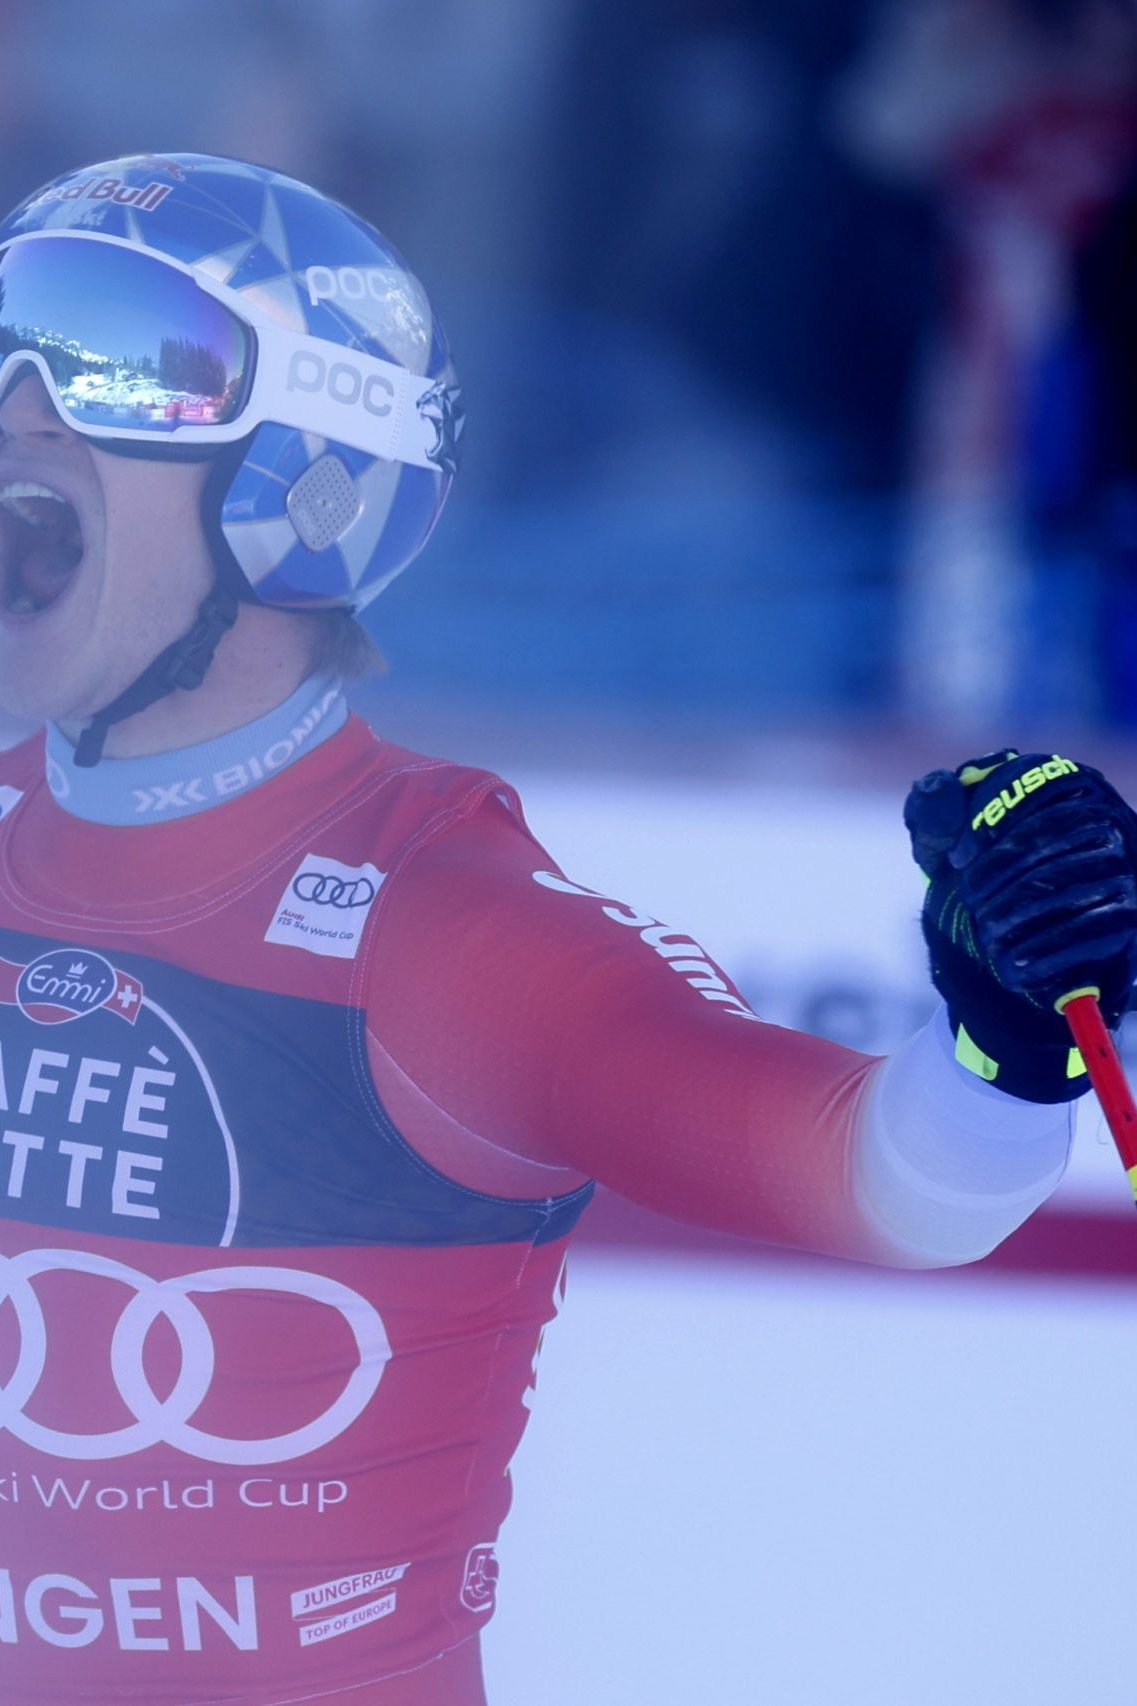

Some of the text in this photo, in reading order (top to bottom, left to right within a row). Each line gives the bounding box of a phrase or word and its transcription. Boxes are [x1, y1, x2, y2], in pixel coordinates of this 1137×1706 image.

[87, 177, 171, 212] Bull
[971, 754, 1080, 831] reusch
[277, 917, 292, 926] FIS
[294, 920, 309, 933] Ski
[310, 927, 337, 939] World
[26, 964, 107, 1003] Emmi
[31, 1475, 215, 1511] World
[238, 1477, 349, 1513] Cup
[302, 1566, 398, 1609] JUNGFRAU
[305, 1599, 392, 1640] TOP OF EUROPE
